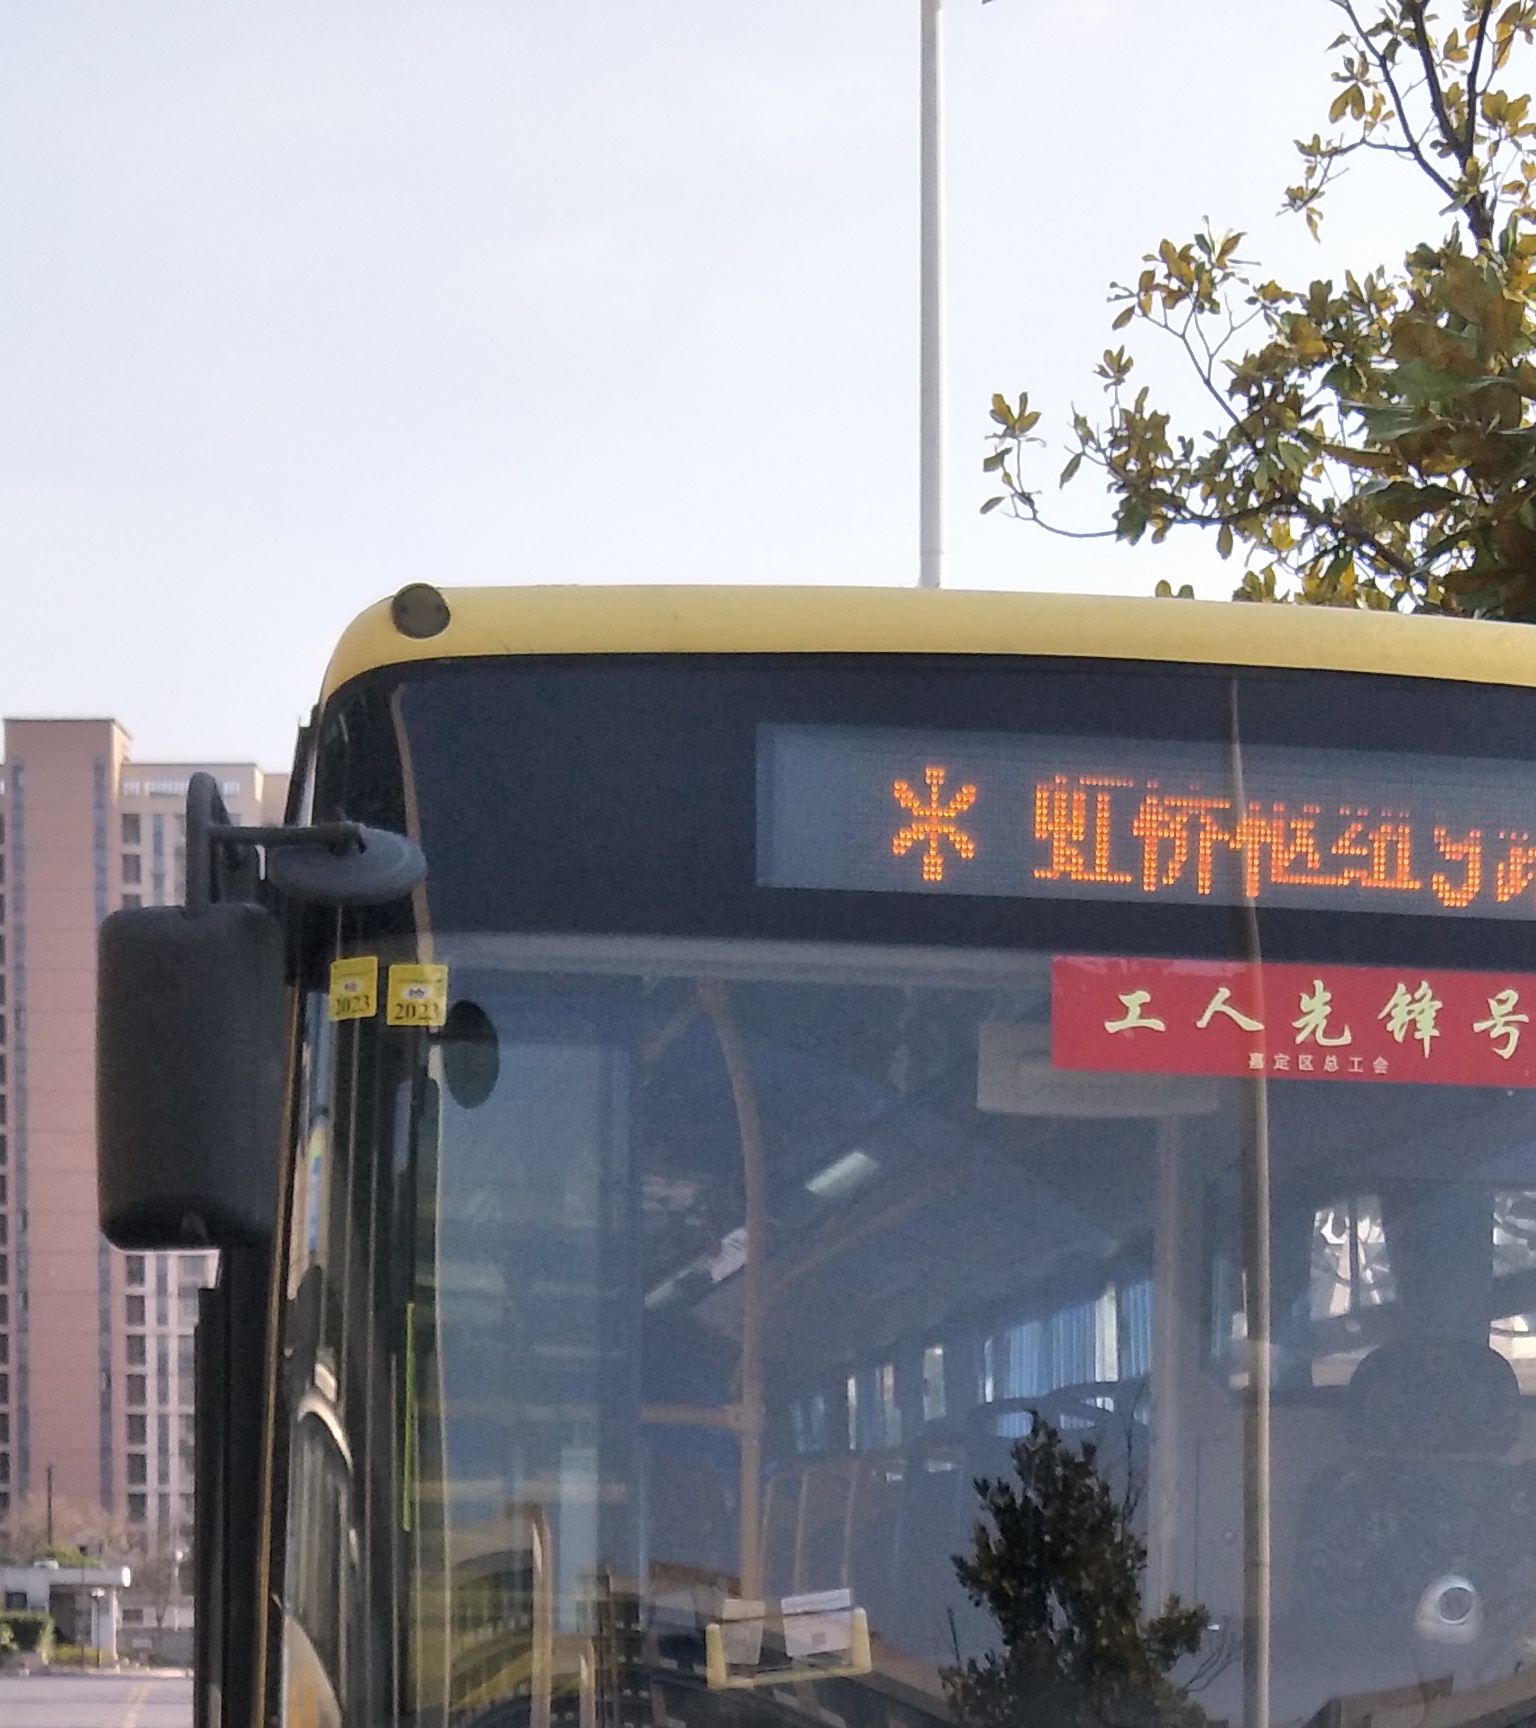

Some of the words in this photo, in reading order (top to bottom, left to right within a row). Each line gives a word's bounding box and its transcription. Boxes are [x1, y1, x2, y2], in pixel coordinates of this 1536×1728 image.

[395, 1003, 440, 1020] 2023
[1104, 979, 1530, 1061] 工人先锋号
[1248, 1052, 1390, 1075] 嘉定区总工会
